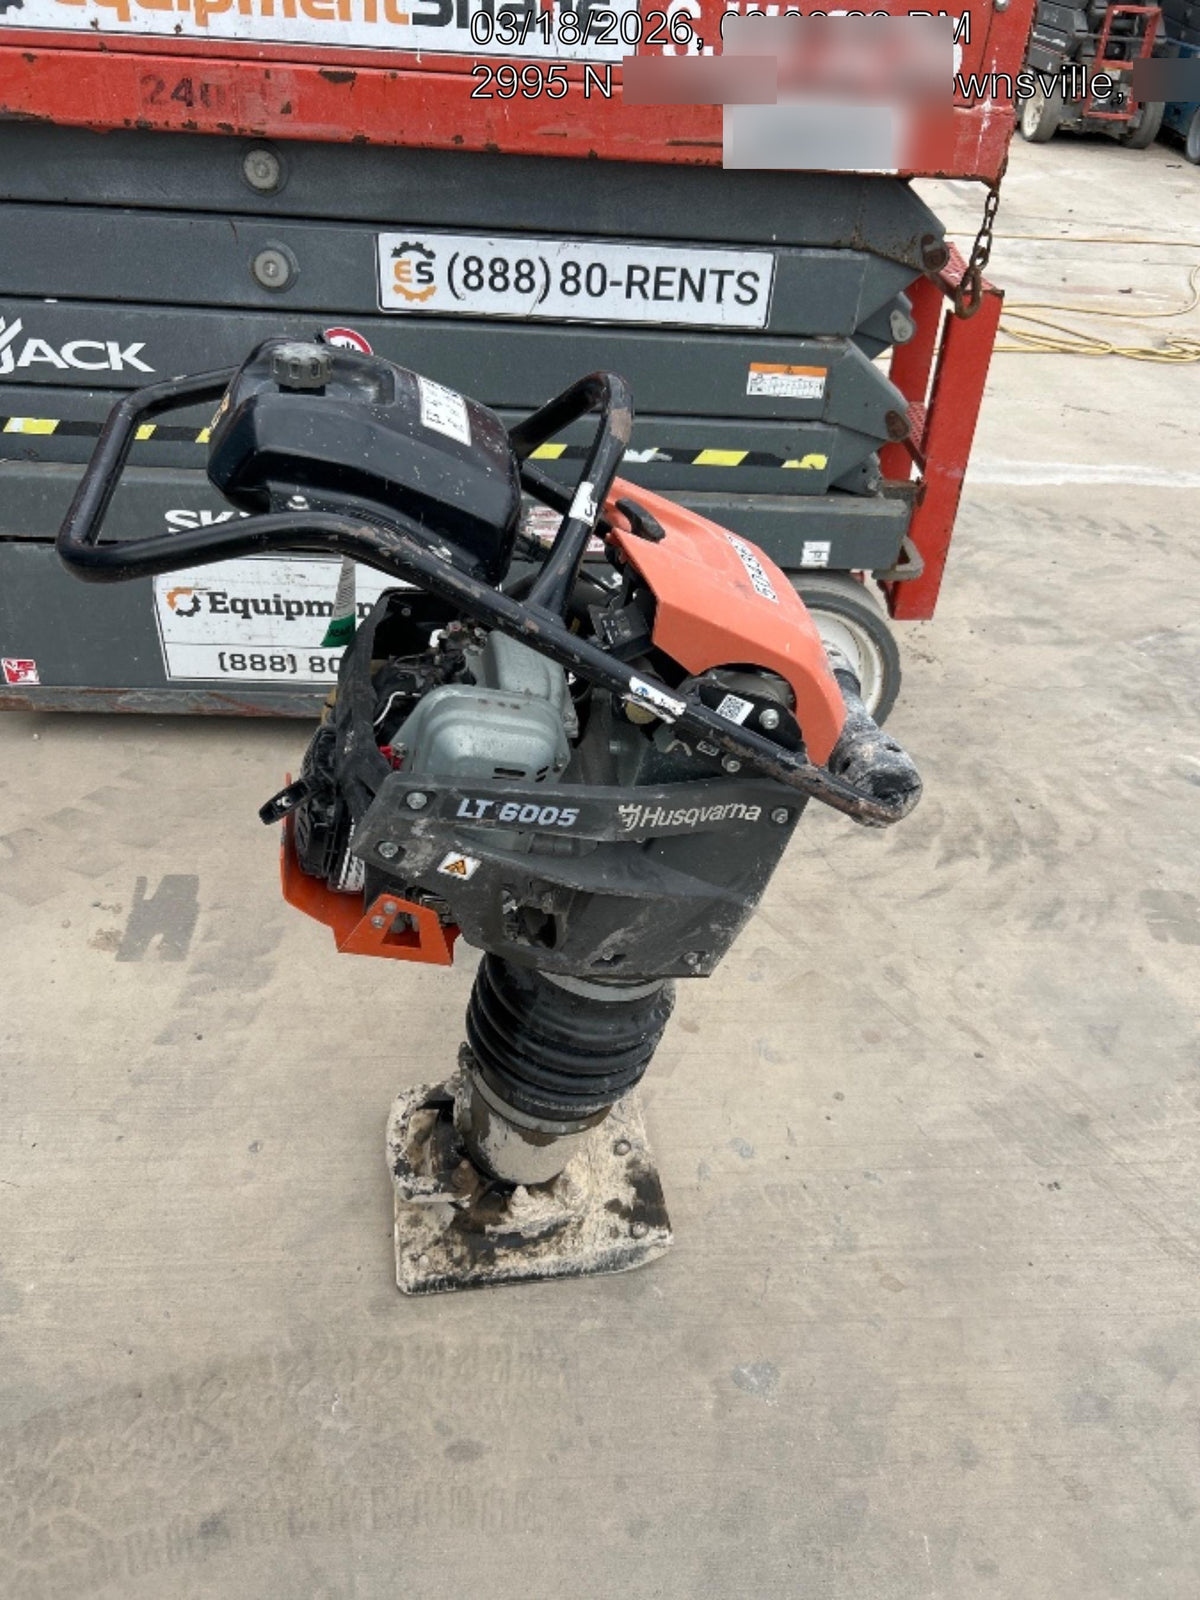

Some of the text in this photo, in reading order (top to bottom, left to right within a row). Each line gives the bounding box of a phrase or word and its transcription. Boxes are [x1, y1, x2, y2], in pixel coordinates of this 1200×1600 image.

[218, 651, 297, 674] (888)
[456, 797, 580, 827] LT 6005
[639, 802, 762, 828] Husqvarna
